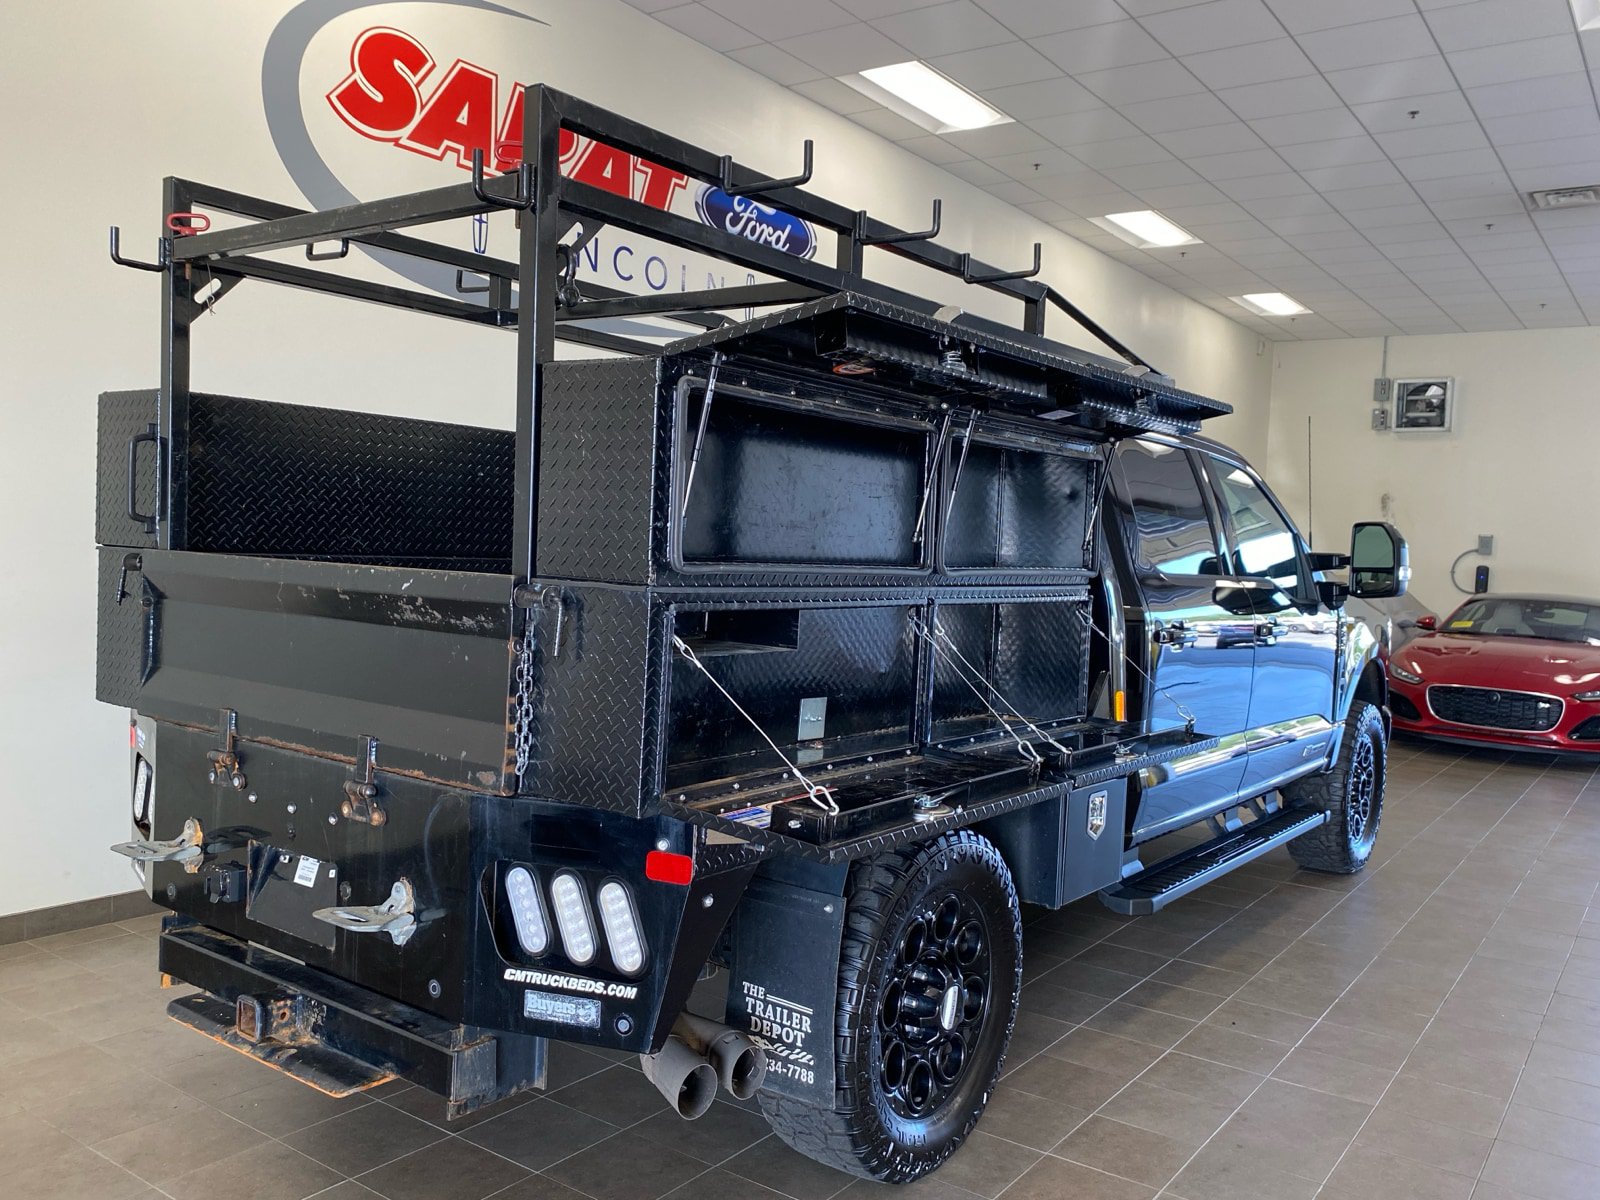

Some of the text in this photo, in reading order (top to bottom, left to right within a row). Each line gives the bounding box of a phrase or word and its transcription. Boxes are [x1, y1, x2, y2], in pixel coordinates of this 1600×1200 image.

[725, 195, 790, 253] Ford
[503, 968, 638, 999] CMTRUCKBEDS.COM
[742, 981, 766, 999] THE
[527, 992, 576, 1015] Buyers
[745, 996, 812, 1033] TRAILER
[750, 1015, 806, 1047] DEPOT
